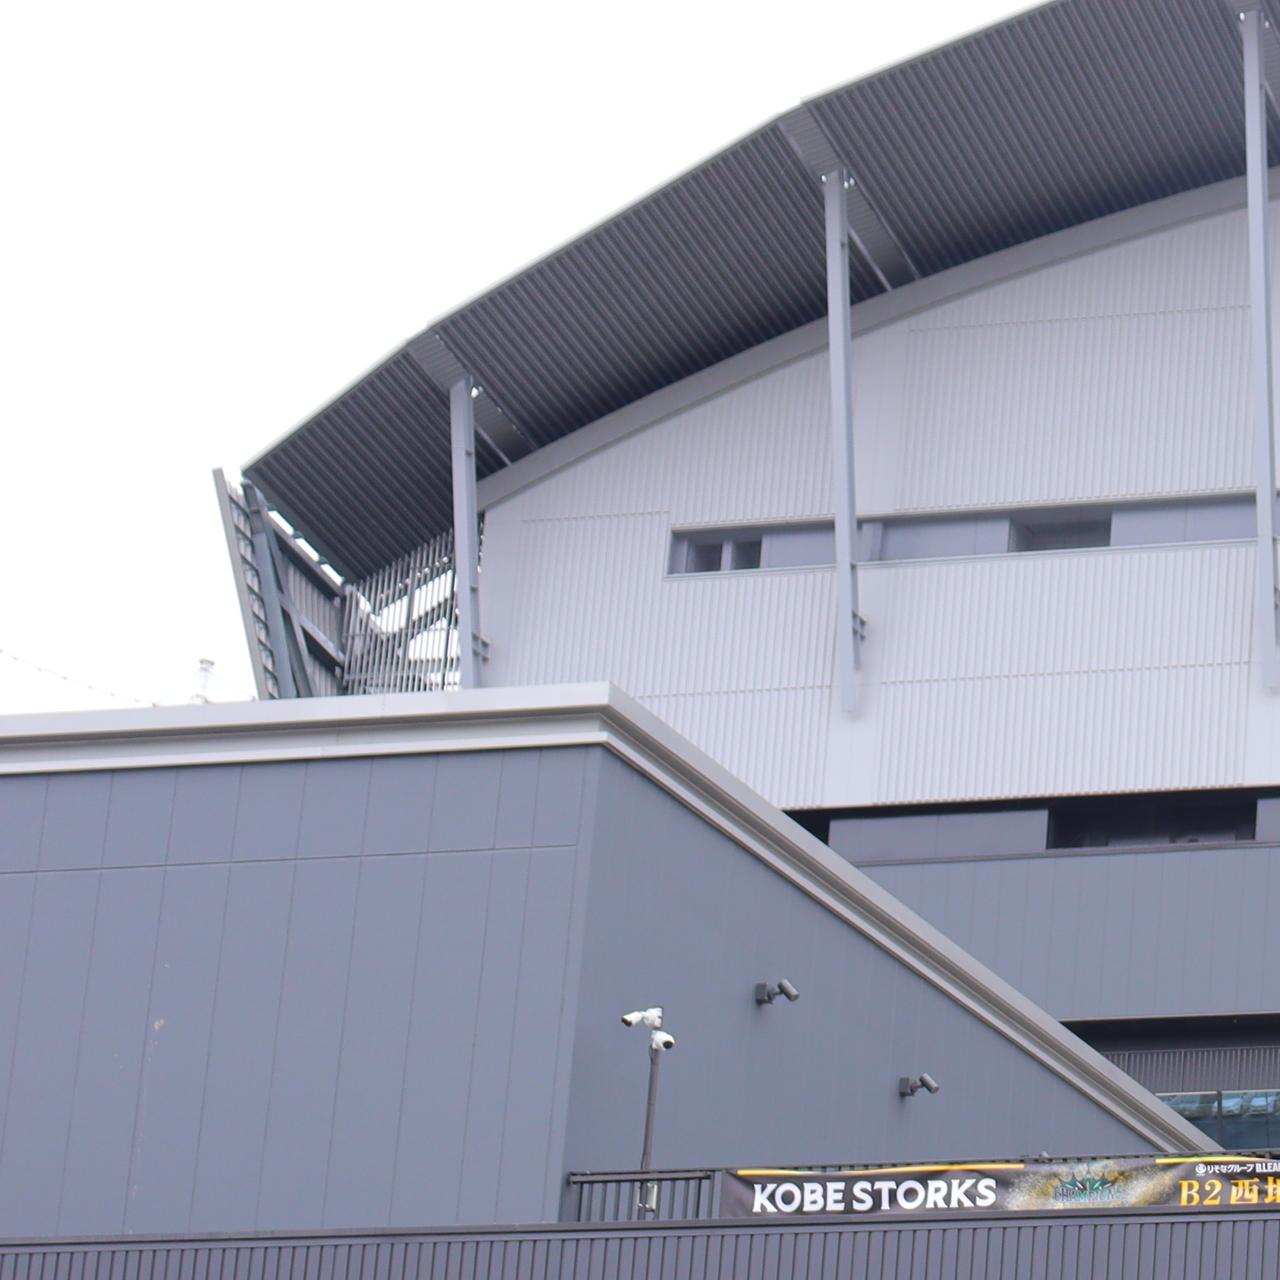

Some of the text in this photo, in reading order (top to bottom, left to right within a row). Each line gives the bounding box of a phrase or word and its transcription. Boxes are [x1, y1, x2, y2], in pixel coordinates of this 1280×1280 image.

[1207, 1163, 1254, 1174] りそなグループ
[752, 1177, 997, 1213] KOBE STORKS
